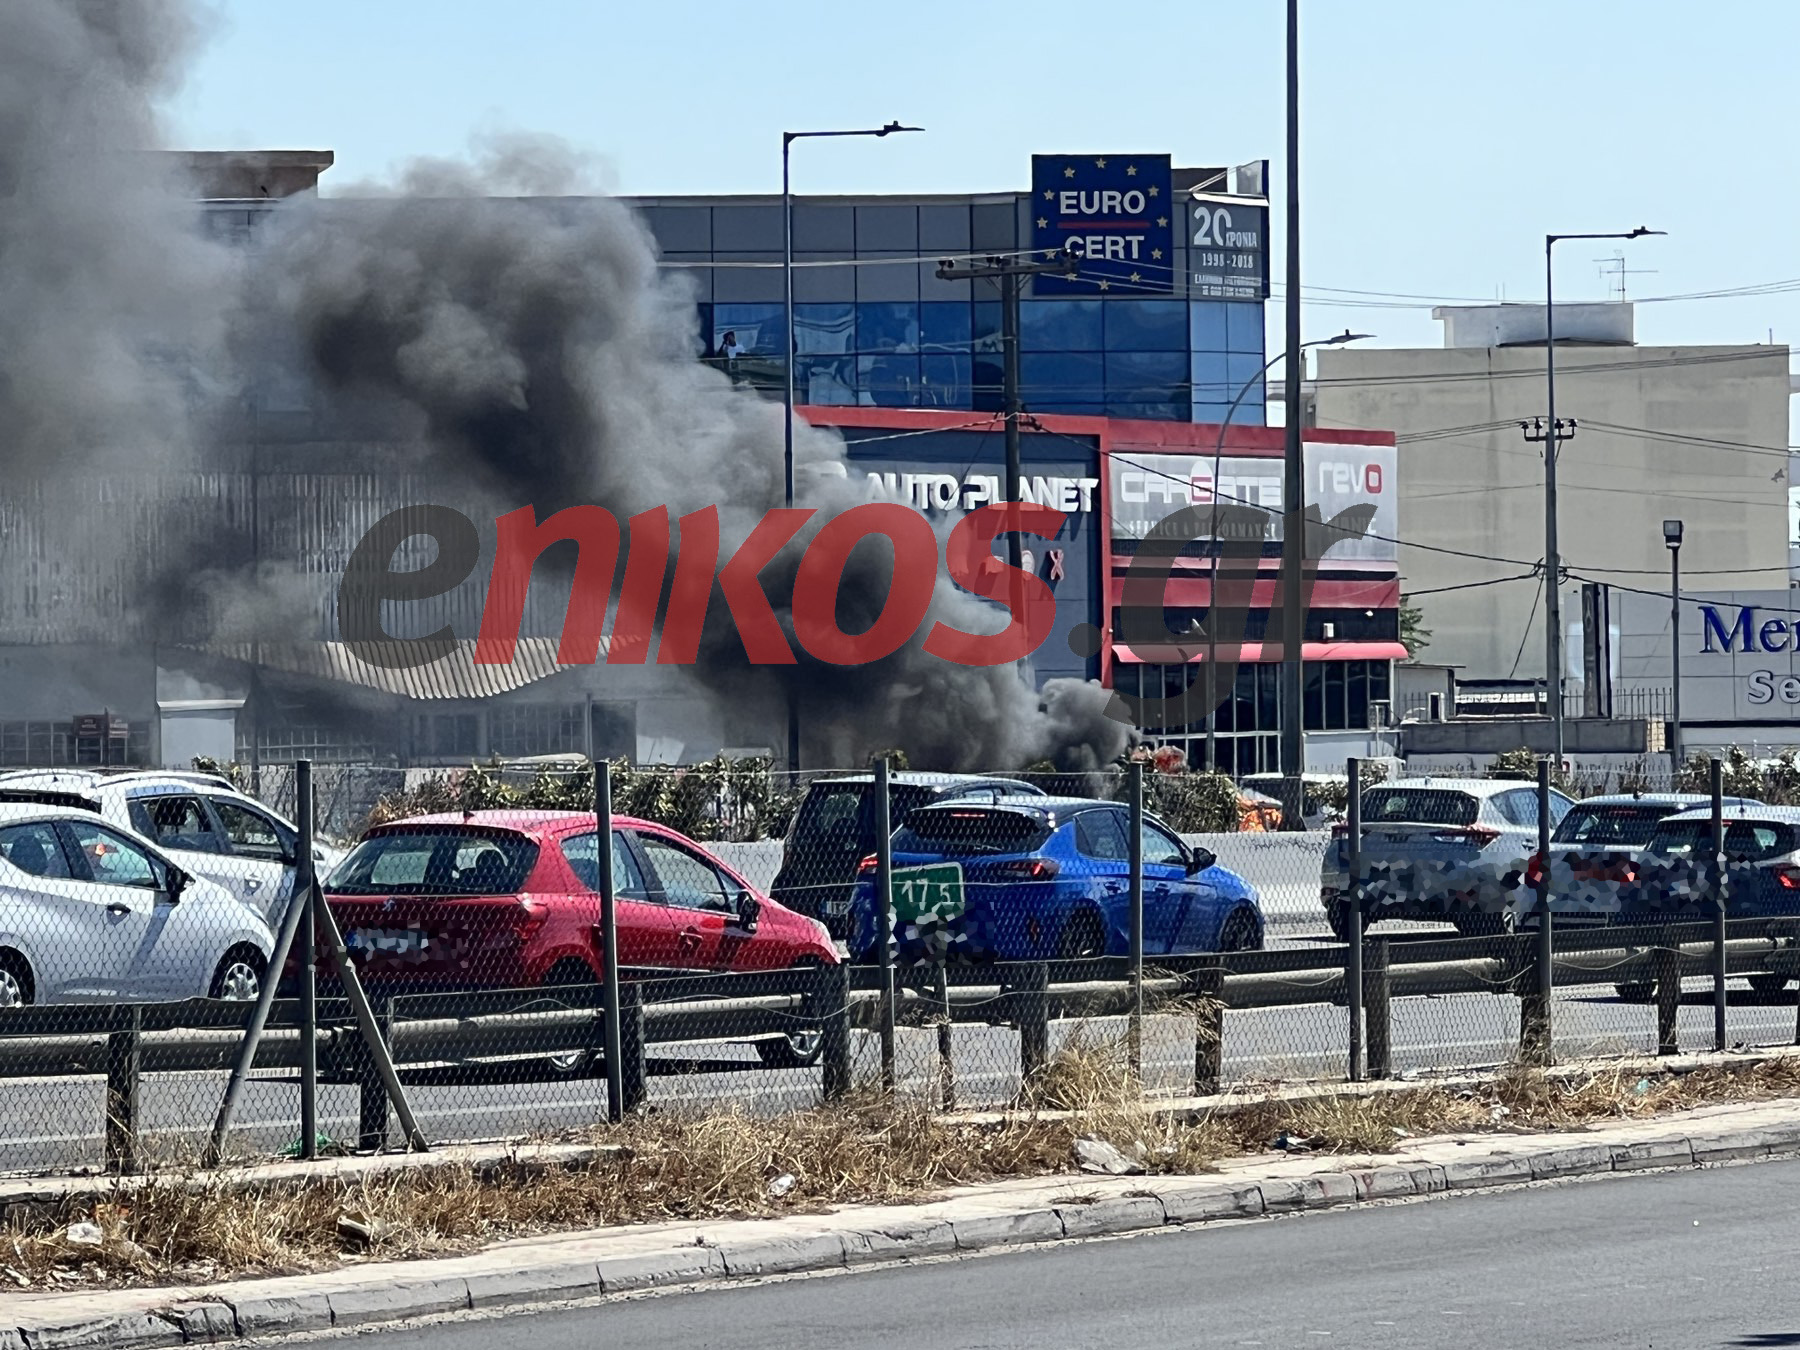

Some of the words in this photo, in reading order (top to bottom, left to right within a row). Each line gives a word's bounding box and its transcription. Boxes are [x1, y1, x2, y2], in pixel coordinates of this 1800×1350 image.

[1059, 190, 1145, 214] EURO
[1193, 206, 1232, 246] 20
[1064, 235, 1145, 260] CERT
[865, 471, 959, 511] AUTO
[963, 474, 1099, 513] PLANET
[1121, 472, 1282, 506] CARGATE
[1318, 461, 1383, 495] revo
[1129, 520, 1178, 537] SERVICE
[1748, 669, 1800, 704] Se
